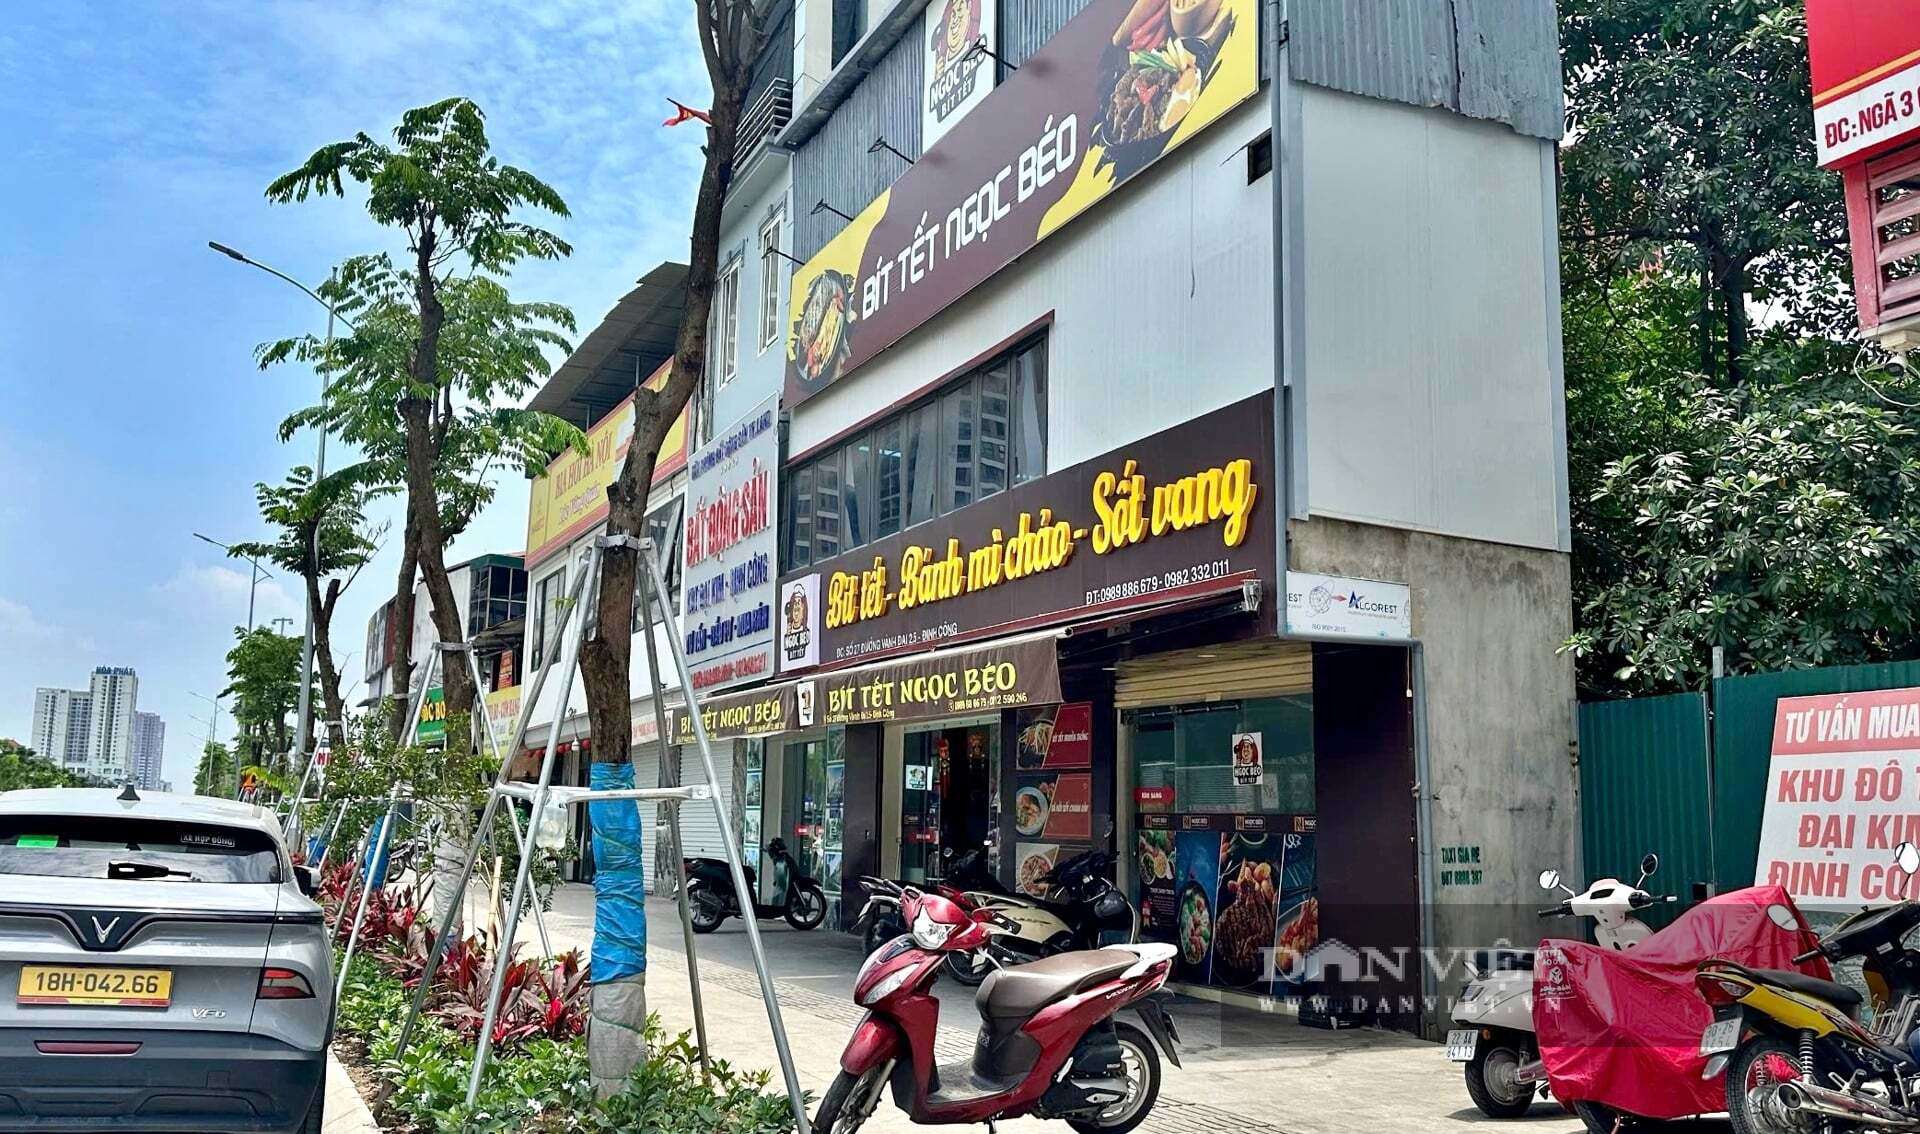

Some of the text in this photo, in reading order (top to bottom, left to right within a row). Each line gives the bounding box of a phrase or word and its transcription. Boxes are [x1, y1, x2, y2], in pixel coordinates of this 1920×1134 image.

[1900, 90, 1913, 118] 3
[862, 114, 1077, 321] BÍT TẾT NGỌC BÉO
[687, 496, 708, 568] BẤT
[708, 485, 741, 561] ĐỘNG
[741, 457, 769, 537] SẢN
[898, 538, 967, 610] Bánh
[1004, 508, 1074, 581] chảo
[1092, 459, 1149, 555] Sốt
[1151, 459, 1257, 548] vang
[747, 551, 768, 589] CÔNG
[1121, 580, 1139, 597] 886
[1140, 576, 1158, 593] 679
[1164, 571, 1189, 587] 0982
[1191, 563, 1211, 582] 332
[1212, 558, 1230, 578] 011
[938, 619, 958, 638] CÔNG
[828, 661, 1017, 713] BÍT TẾT NGỌC BÉO
[720, 705, 752, 729] NGỌC
[754, 698, 781, 723] BÉO
[1785, 697, 1920, 744] TƯ VẤN MUA
[1250, 765, 1262, 777] BÉO
[1777, 768, 1845, 803] KHU
[1855, 759, 1904, 802] ĐÔ
[1798, 814, 1856, 856] ĐẠI
[1768, 860, 1849, 904] ĐỊNH
[36, 972, 158, 994] 18H-042.66
